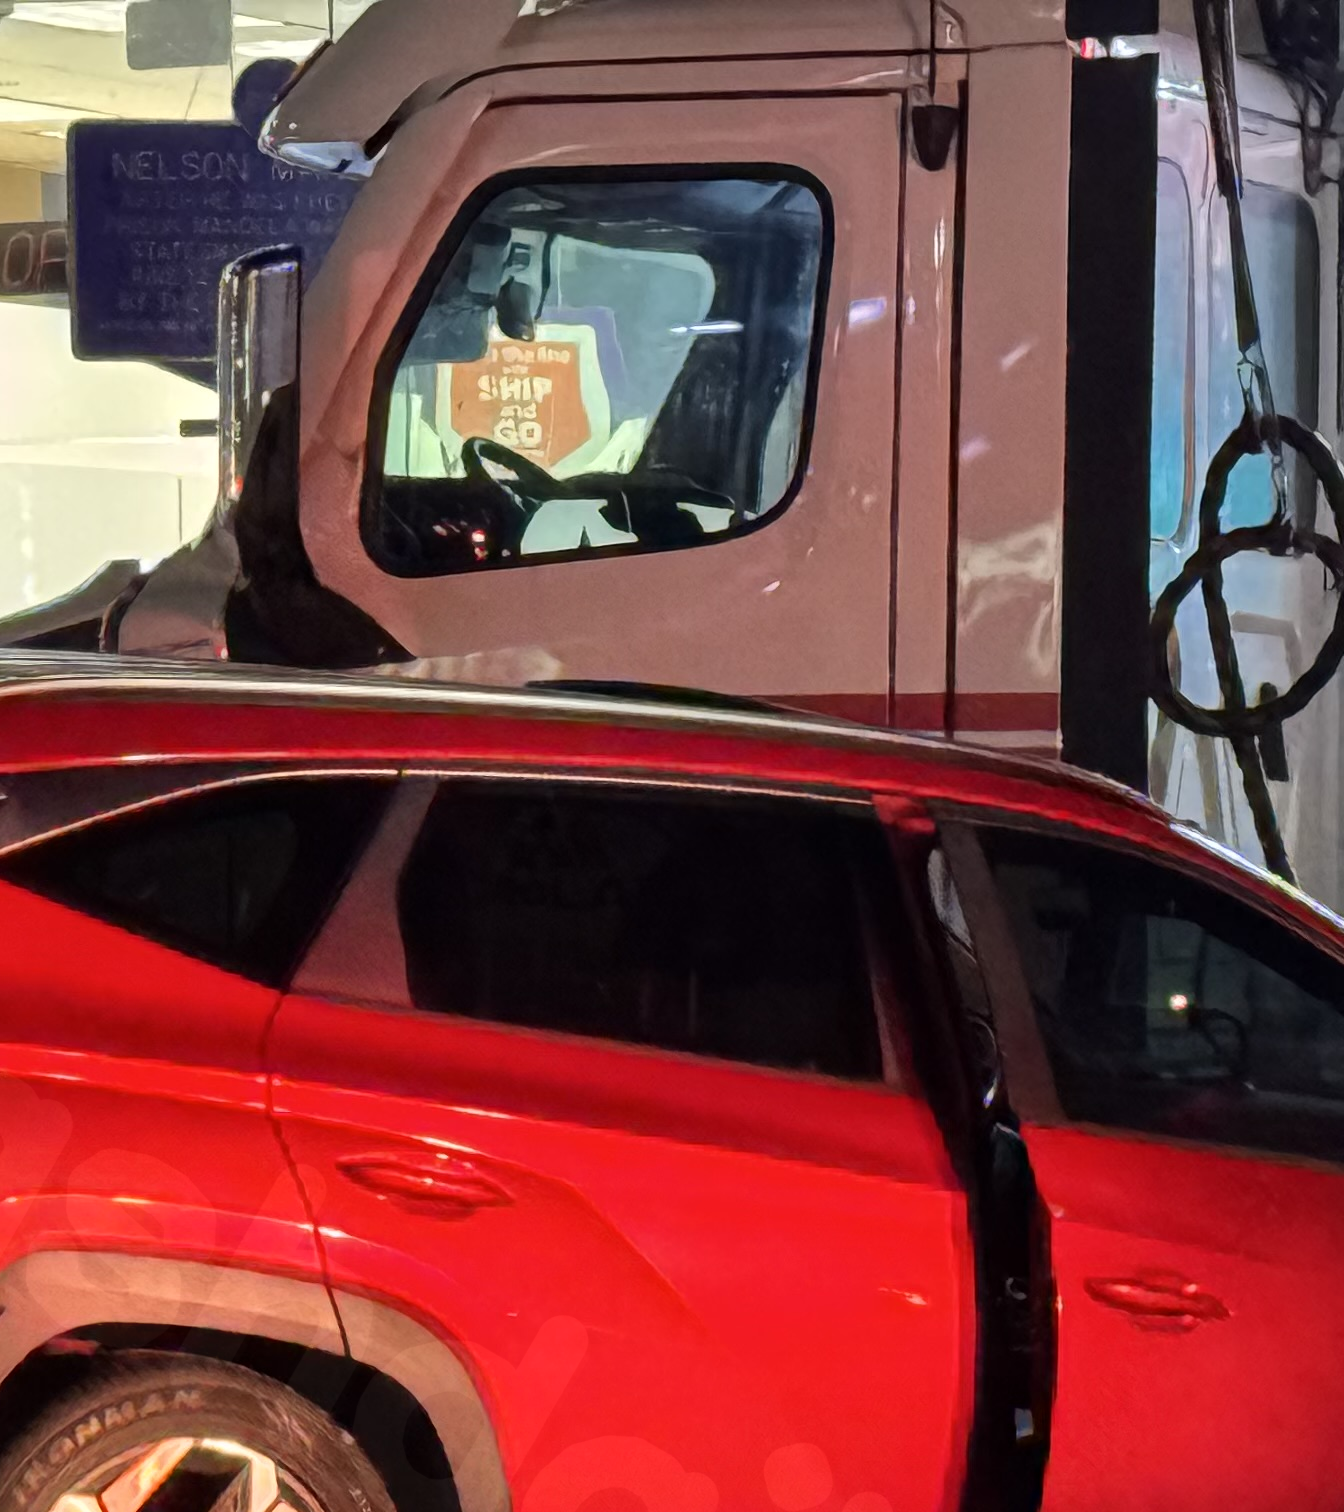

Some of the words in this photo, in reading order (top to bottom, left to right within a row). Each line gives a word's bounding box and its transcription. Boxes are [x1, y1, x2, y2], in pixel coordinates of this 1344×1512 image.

[111, 151, 249, 182] NELSON
[476, 373, 553, 403] SHIP
[493, 418, 543, 450] GO
[13, 1388, 203, 1506] IRONMAN
